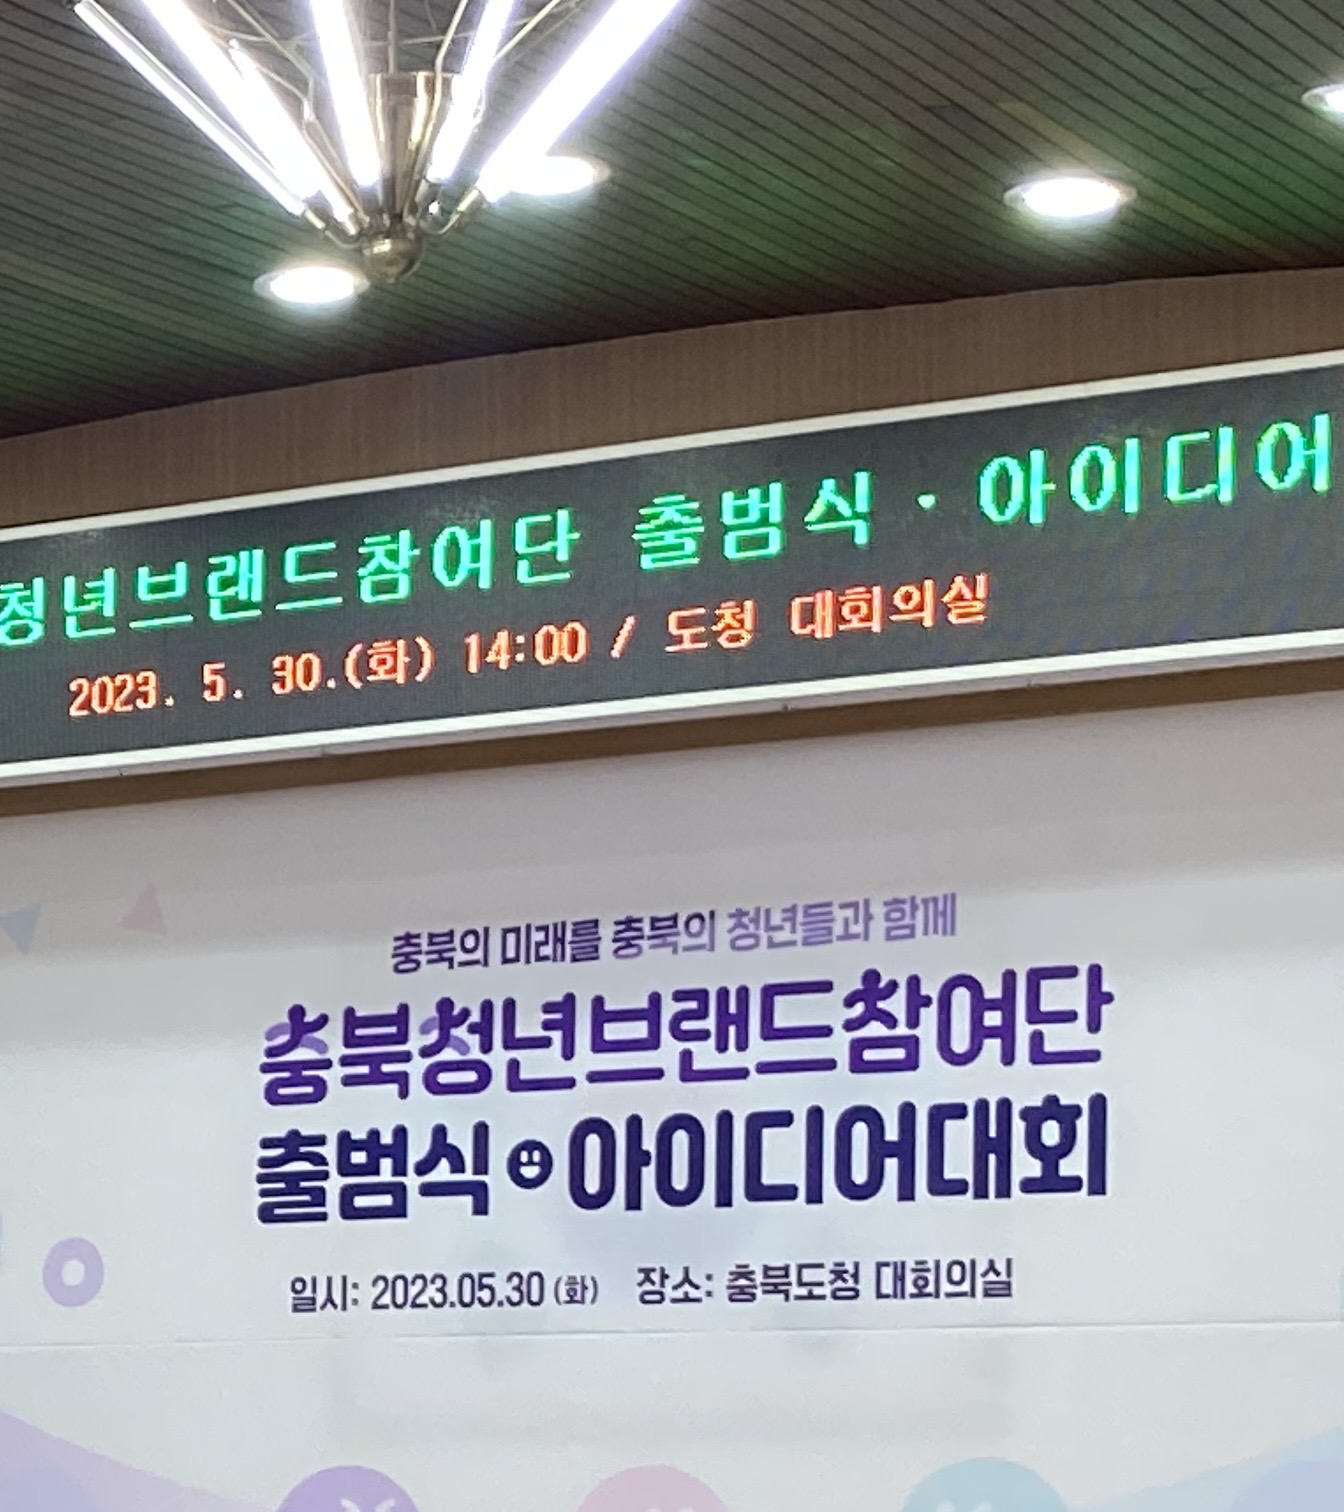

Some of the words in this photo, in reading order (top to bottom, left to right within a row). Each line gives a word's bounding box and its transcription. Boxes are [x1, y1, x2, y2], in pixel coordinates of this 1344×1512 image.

[632, 471, 872, 571] 출범식
[979, 413, 1331, 525] 아이디어
[69, 670, 175, 719] 2023.
[203, 661, 244, 703] 5.
[272, 636, 435, 695] 30.(화)
[464, 620, 589, 674] 14:00
[665, 599, 758, 653] 도청
[788, 573, 988, 639] 대회의실
[391, 926, 490, 974] 충북의
[501, 919, 602, 967] 미래를
[612, 910, 716, 960] 충북의
[726, 898, 874, 952] 청년들과
[883, 893, 958, 943] 함께
[259, 963, 1114, 1106] 충북청년브랜드참여단
[256, 1120, 490, 1224] 출범식
[569, 1092, 1107, 1211] 아이디어대회
[290, 1275, 359, 1313] 일시:
[371, 1271, 545, 1310] 2023.05.30
[554, 1275, 599, 1305] (화)
[637, 1265, 714, 1304] 장소:
[726, 1261, 860, 1302] 충북도청
[875, 1257, 1013, 1300] 대회의실
